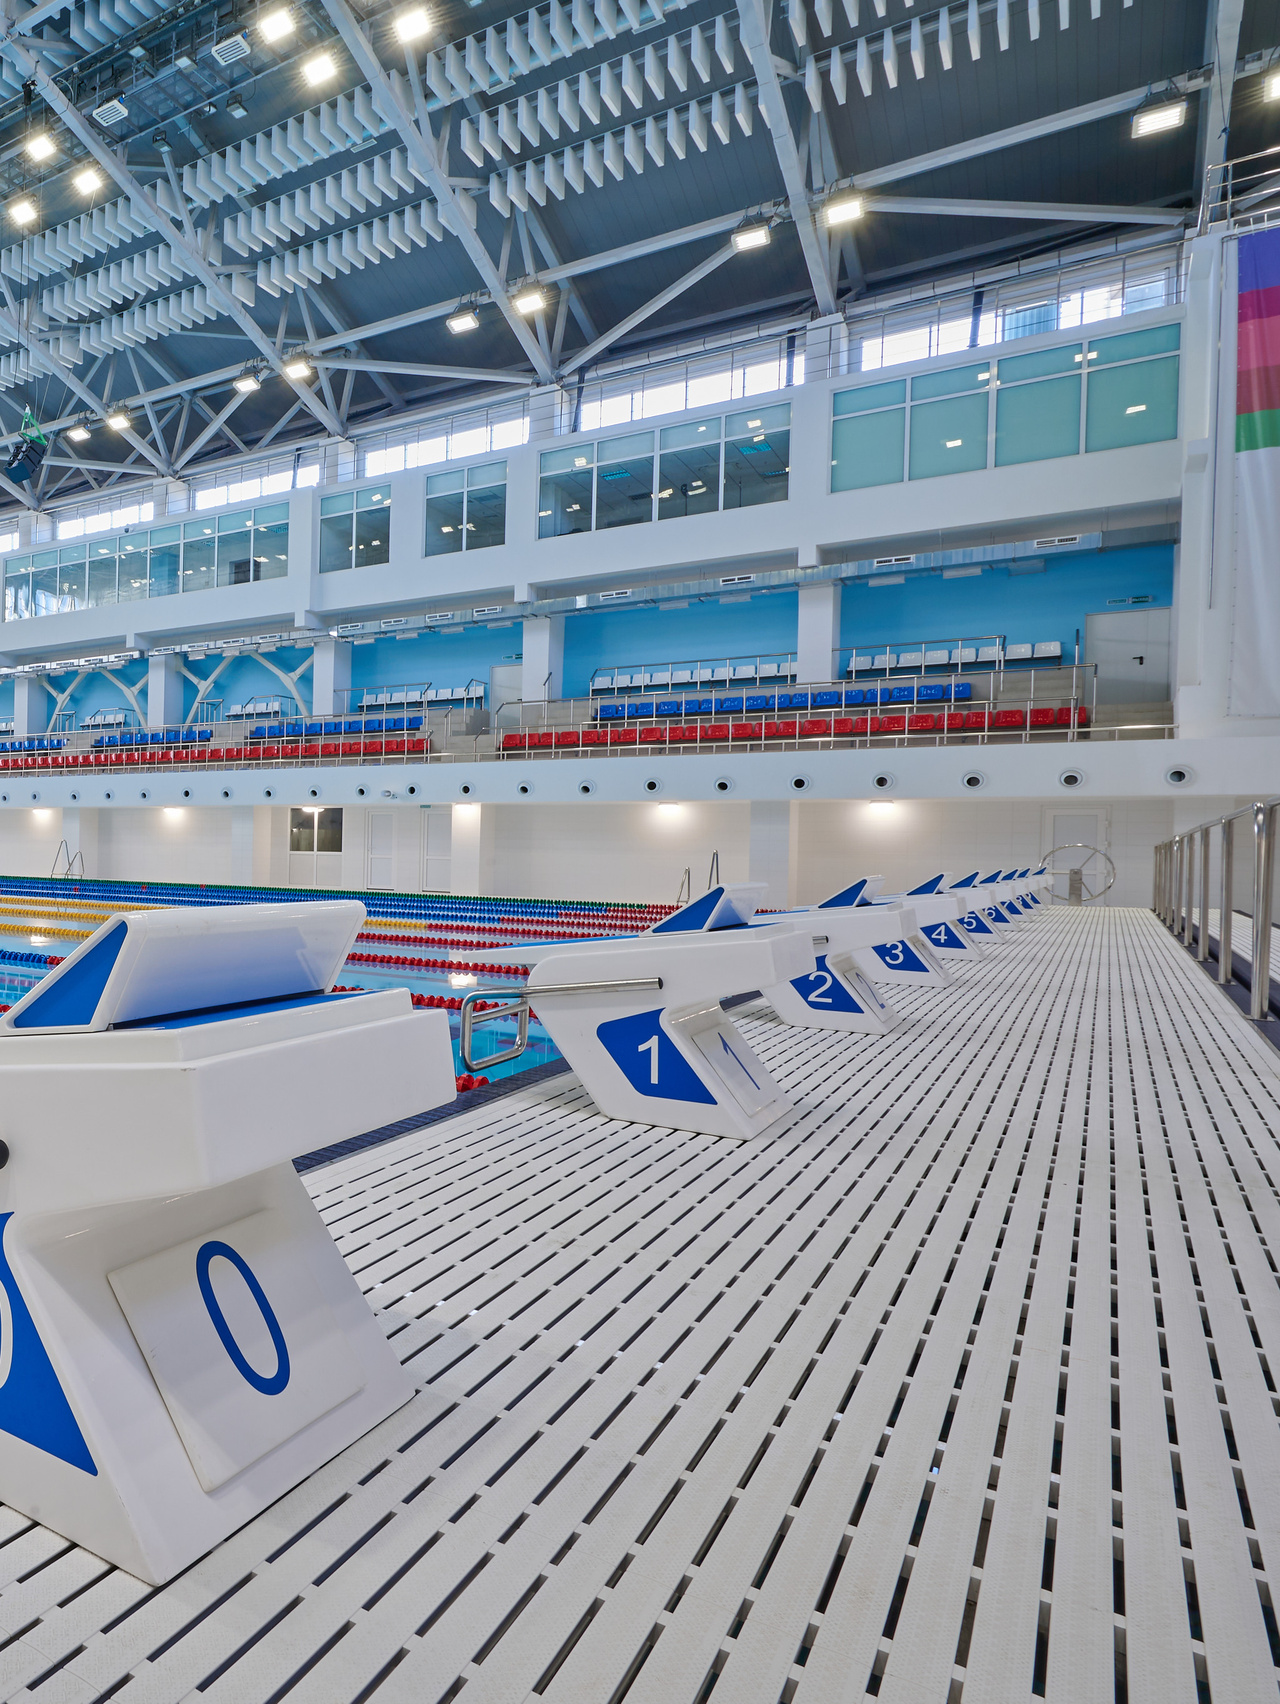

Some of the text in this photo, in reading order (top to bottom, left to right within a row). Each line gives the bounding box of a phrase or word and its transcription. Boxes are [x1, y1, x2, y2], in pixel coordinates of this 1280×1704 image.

[963, 914, 977, 929] 5
[985, 906, 996, 918] 6
[931, 924, 948, 943] 4
[885, 941, 904, 964] 3
[807, 971, 833, 1003] 2
[637, 1035, 659, 1085] 1
[718, 1031, 761, 1091] 1
[195, 1240, 291, 1397] 0
